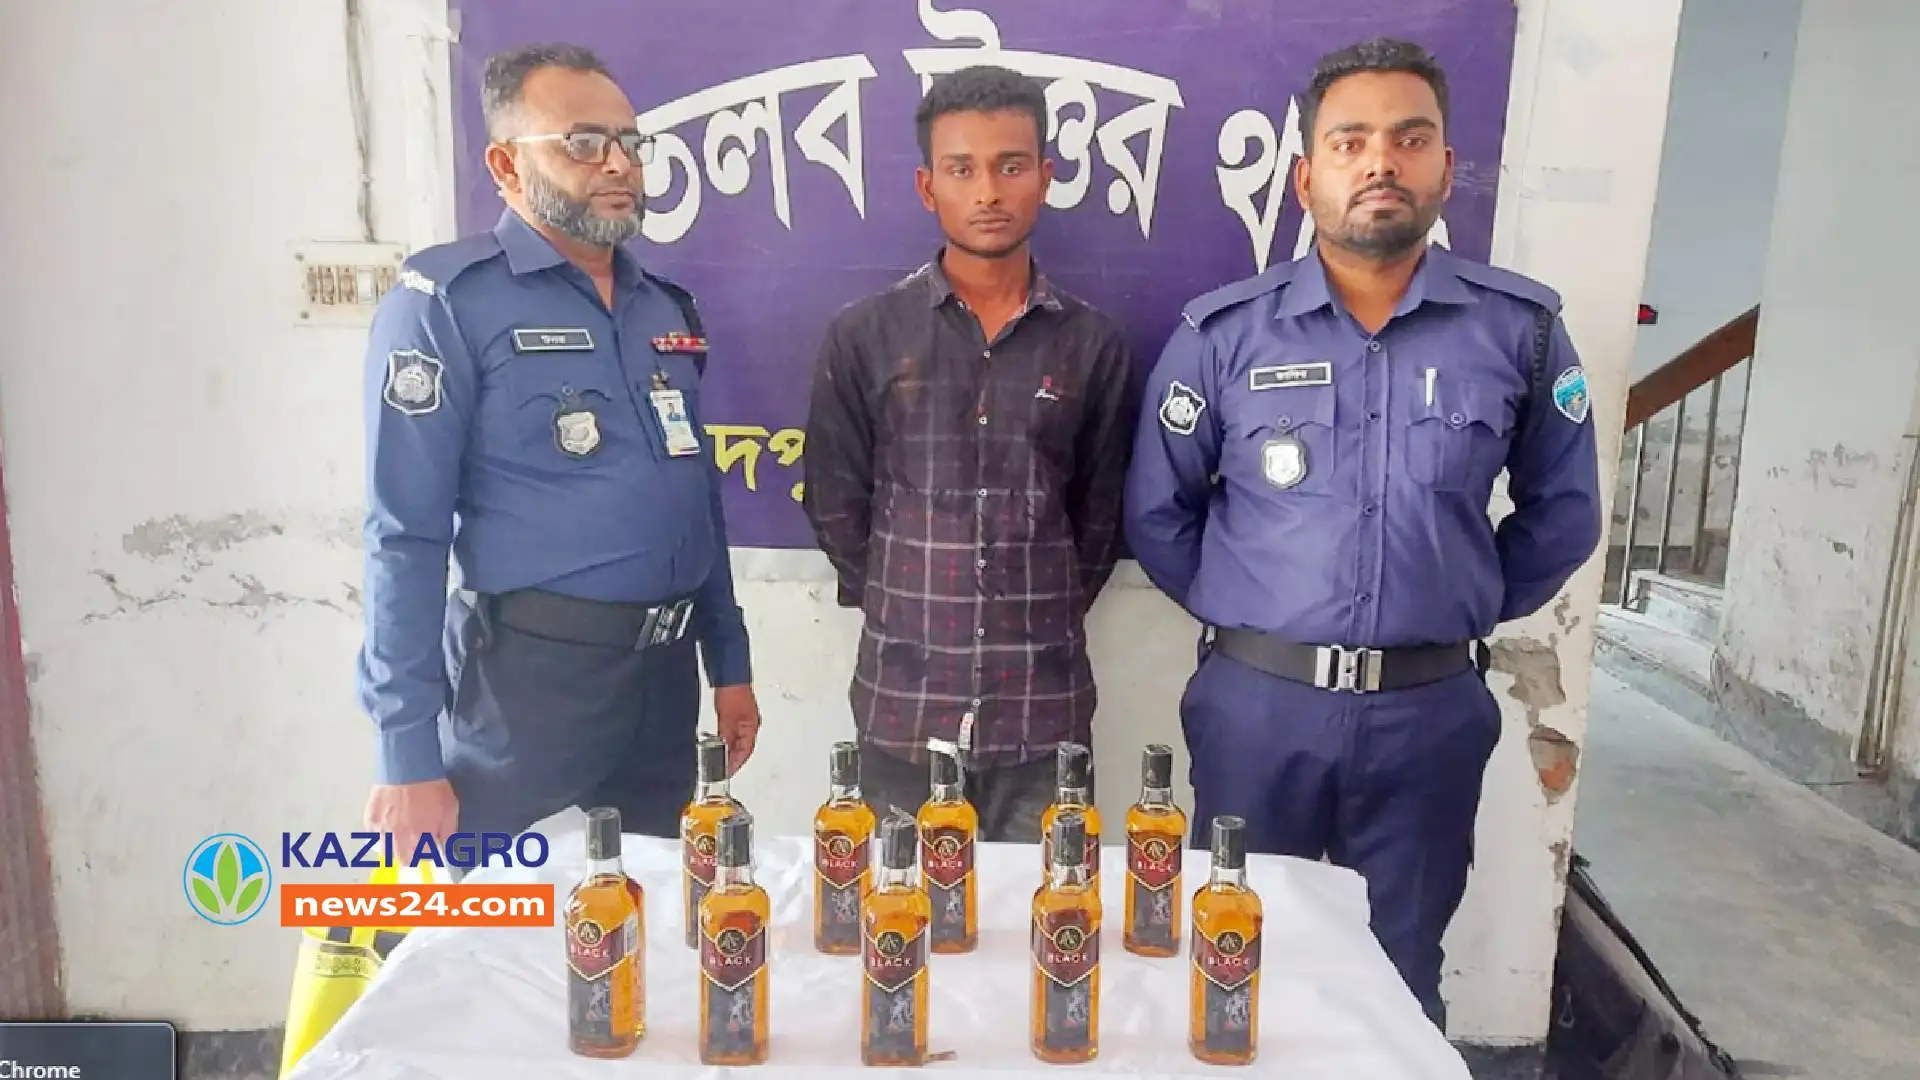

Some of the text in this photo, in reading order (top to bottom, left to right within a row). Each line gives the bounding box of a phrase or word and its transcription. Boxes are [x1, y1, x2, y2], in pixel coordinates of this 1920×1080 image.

[636, 53, 879, 244] তলব
[689, 857, 718, 867] BLAC
[709, 955, 753, 967] BLACK
[869, 956, 912, 968] BLACK
[1046, 953, 1089, 965] BLACK
[1207, 956, 1251, 967] BLACK
